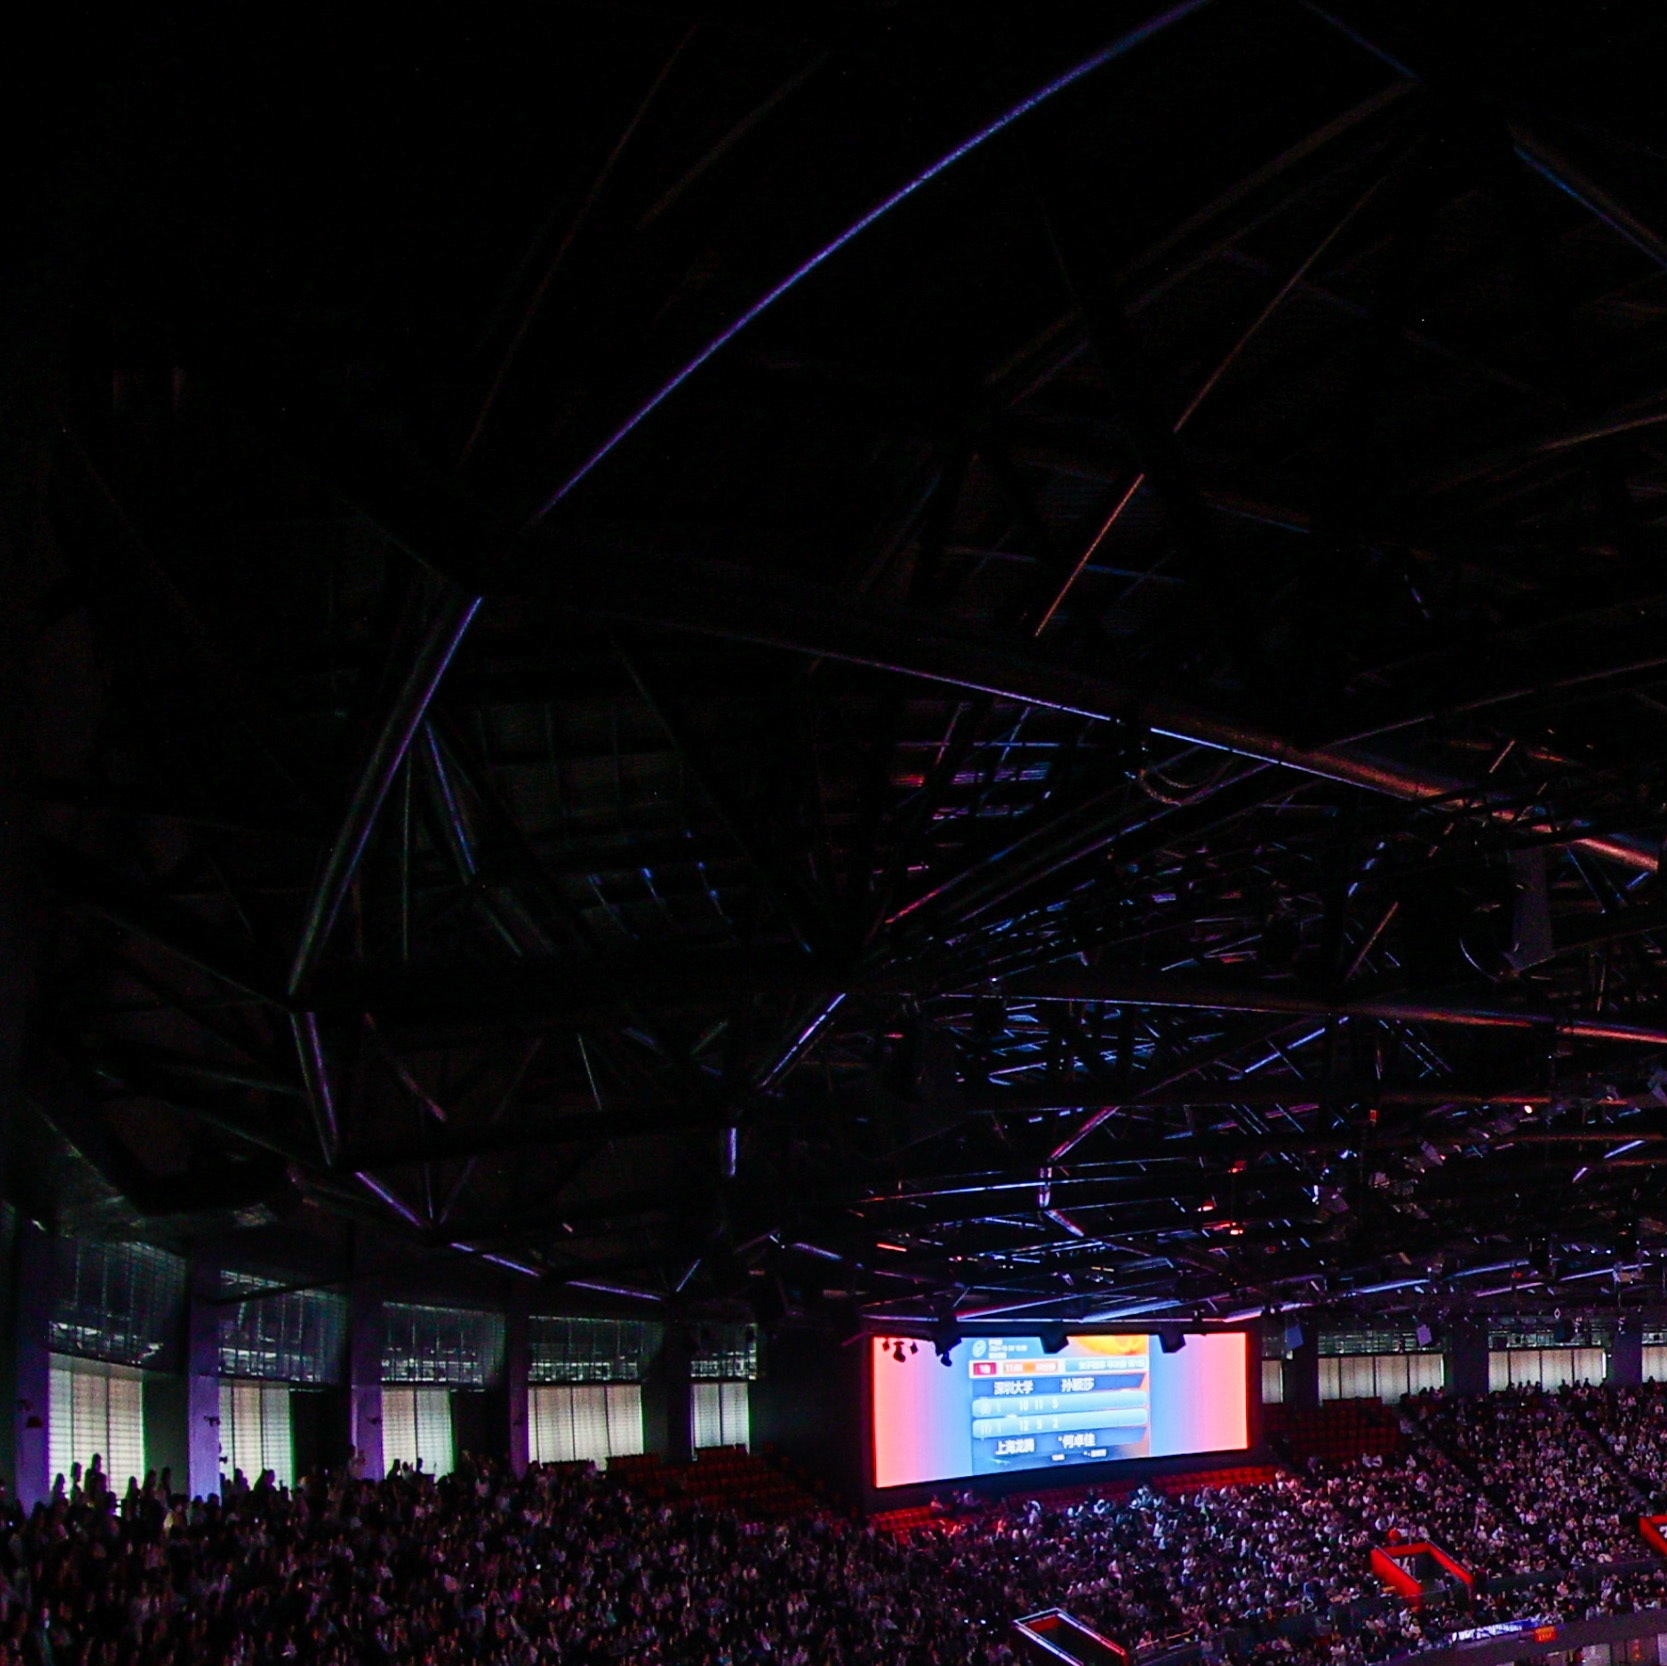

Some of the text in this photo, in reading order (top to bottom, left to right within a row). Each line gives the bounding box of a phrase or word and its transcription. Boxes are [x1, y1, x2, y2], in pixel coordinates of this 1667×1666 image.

[994, 1378, 1095, 1395] 深圳大学 孙颖莎
